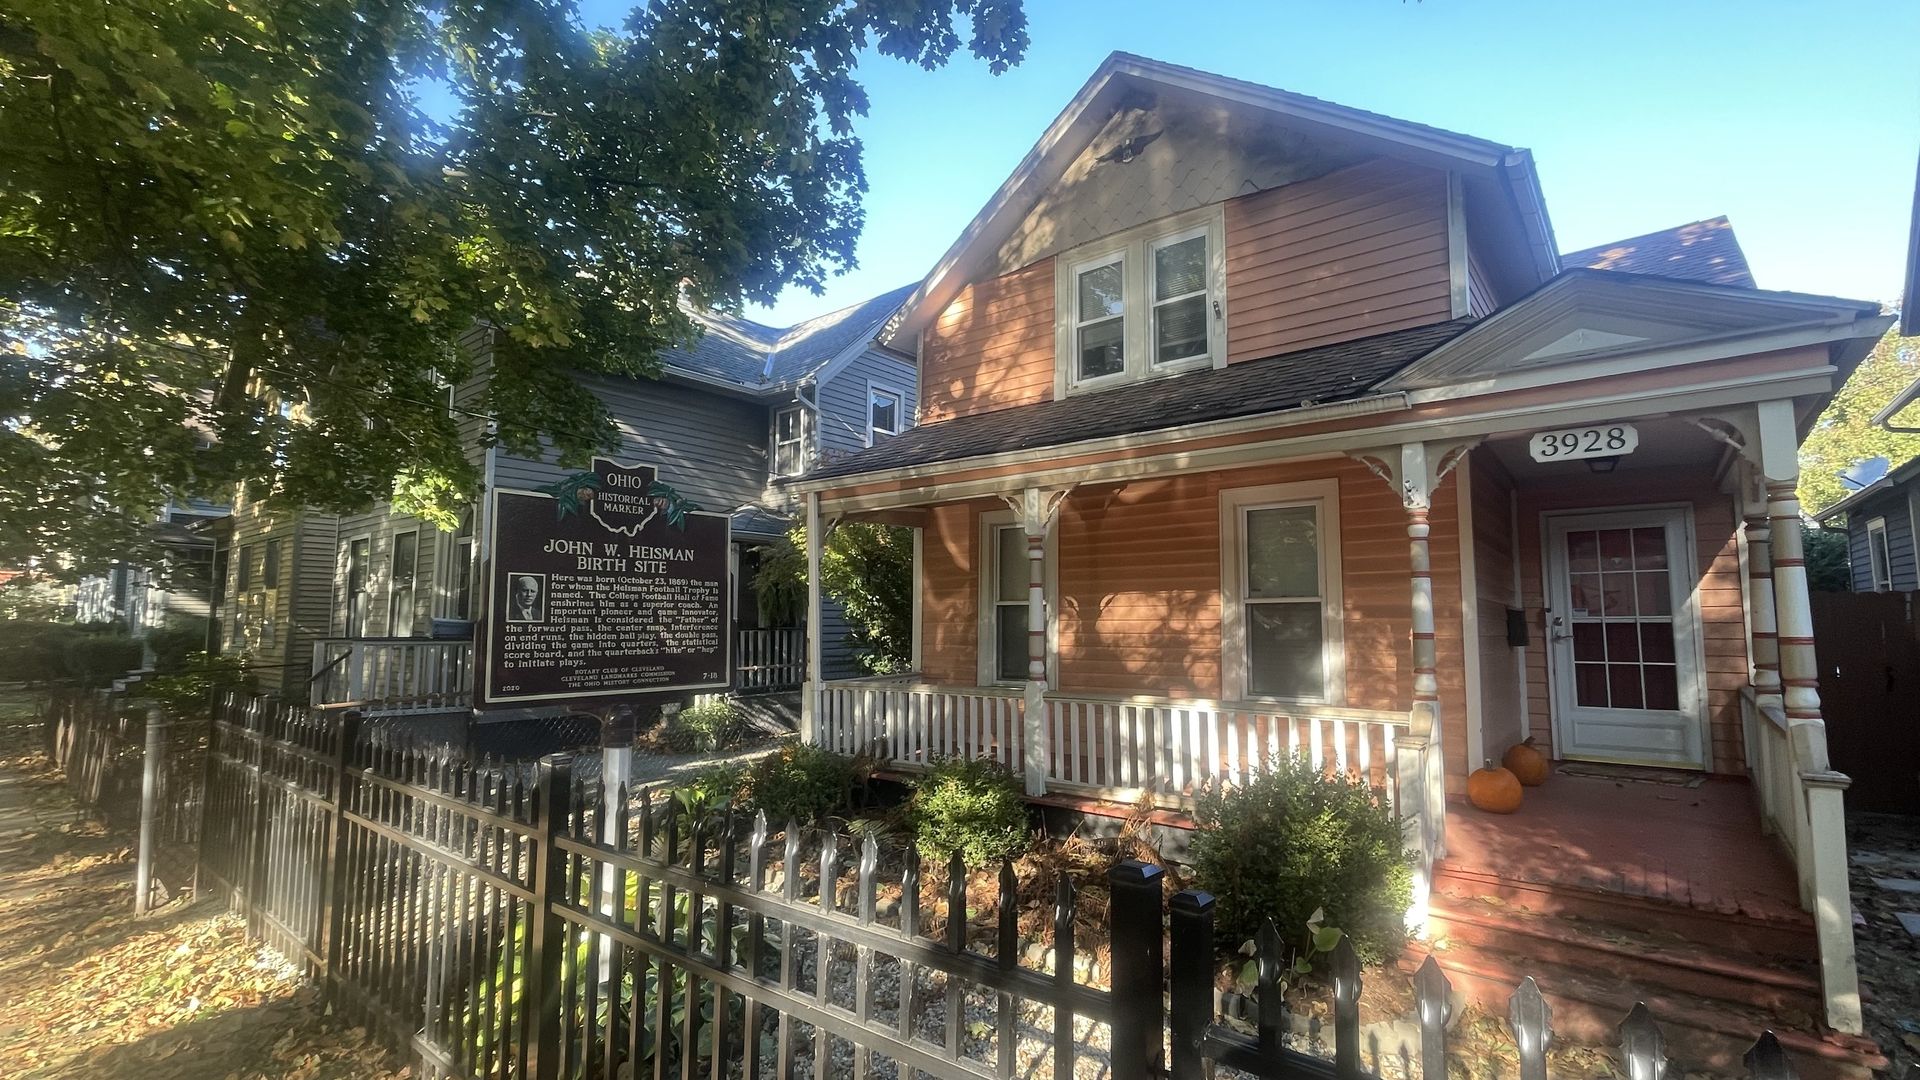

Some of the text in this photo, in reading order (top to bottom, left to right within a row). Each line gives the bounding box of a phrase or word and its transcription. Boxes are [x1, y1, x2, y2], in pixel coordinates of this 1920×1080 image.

[1541, 427, 1626, 457] 3928
[607, 473, 641, 489] OHIO
[598, 492, 650, 506] HISTORICAL
[603, 502, 644, 515] MARKER
[543, 539, 694, 561] JOHN W. HEISMAN
[577, 556, 667, 574] BIRTH SITE
[551, 573, 575, 581] Here
[595, 575, 615, 583] born
[618, 576, 653, 584] (October
[655, 577, 666, 585] 23,
[669, 578, 688, 586] 1869)
[568, 582, 593, 590] whom
[596, 583, 610, 591] the
[613, 584, 647, 592] Heisman
[650, 585, 680, 593] Football
[682, 586, 710, 595] Trophy
[551, 591, 584, 599] named.
[588, 591, 606, 599] The
[608, 592, 639, 600] College
[550, 599, 594, 607] enshrines
[642, 601, 674, 609] superior
[550, 607, 596, 616] important
[601, 608, 633, 616] pioneer
[657, 609, 677, 617] game
[505, 624, 523, 632] the
[527, 624, 566, 632] forward
[597, 624, 612, 632] the
[586, 632, 617, 640] hidden
[619, 632, 635, 640] ball
[504, 642, 547, 650] dividing
[551, 641, 567, 649] the
[571, 642, 594, 650] game
[598, 640, 616, 648] into
[682, 638, 718, 646] statistical
[567, 649, 584, 657] and
[559, 659, 586, 667] plays.
